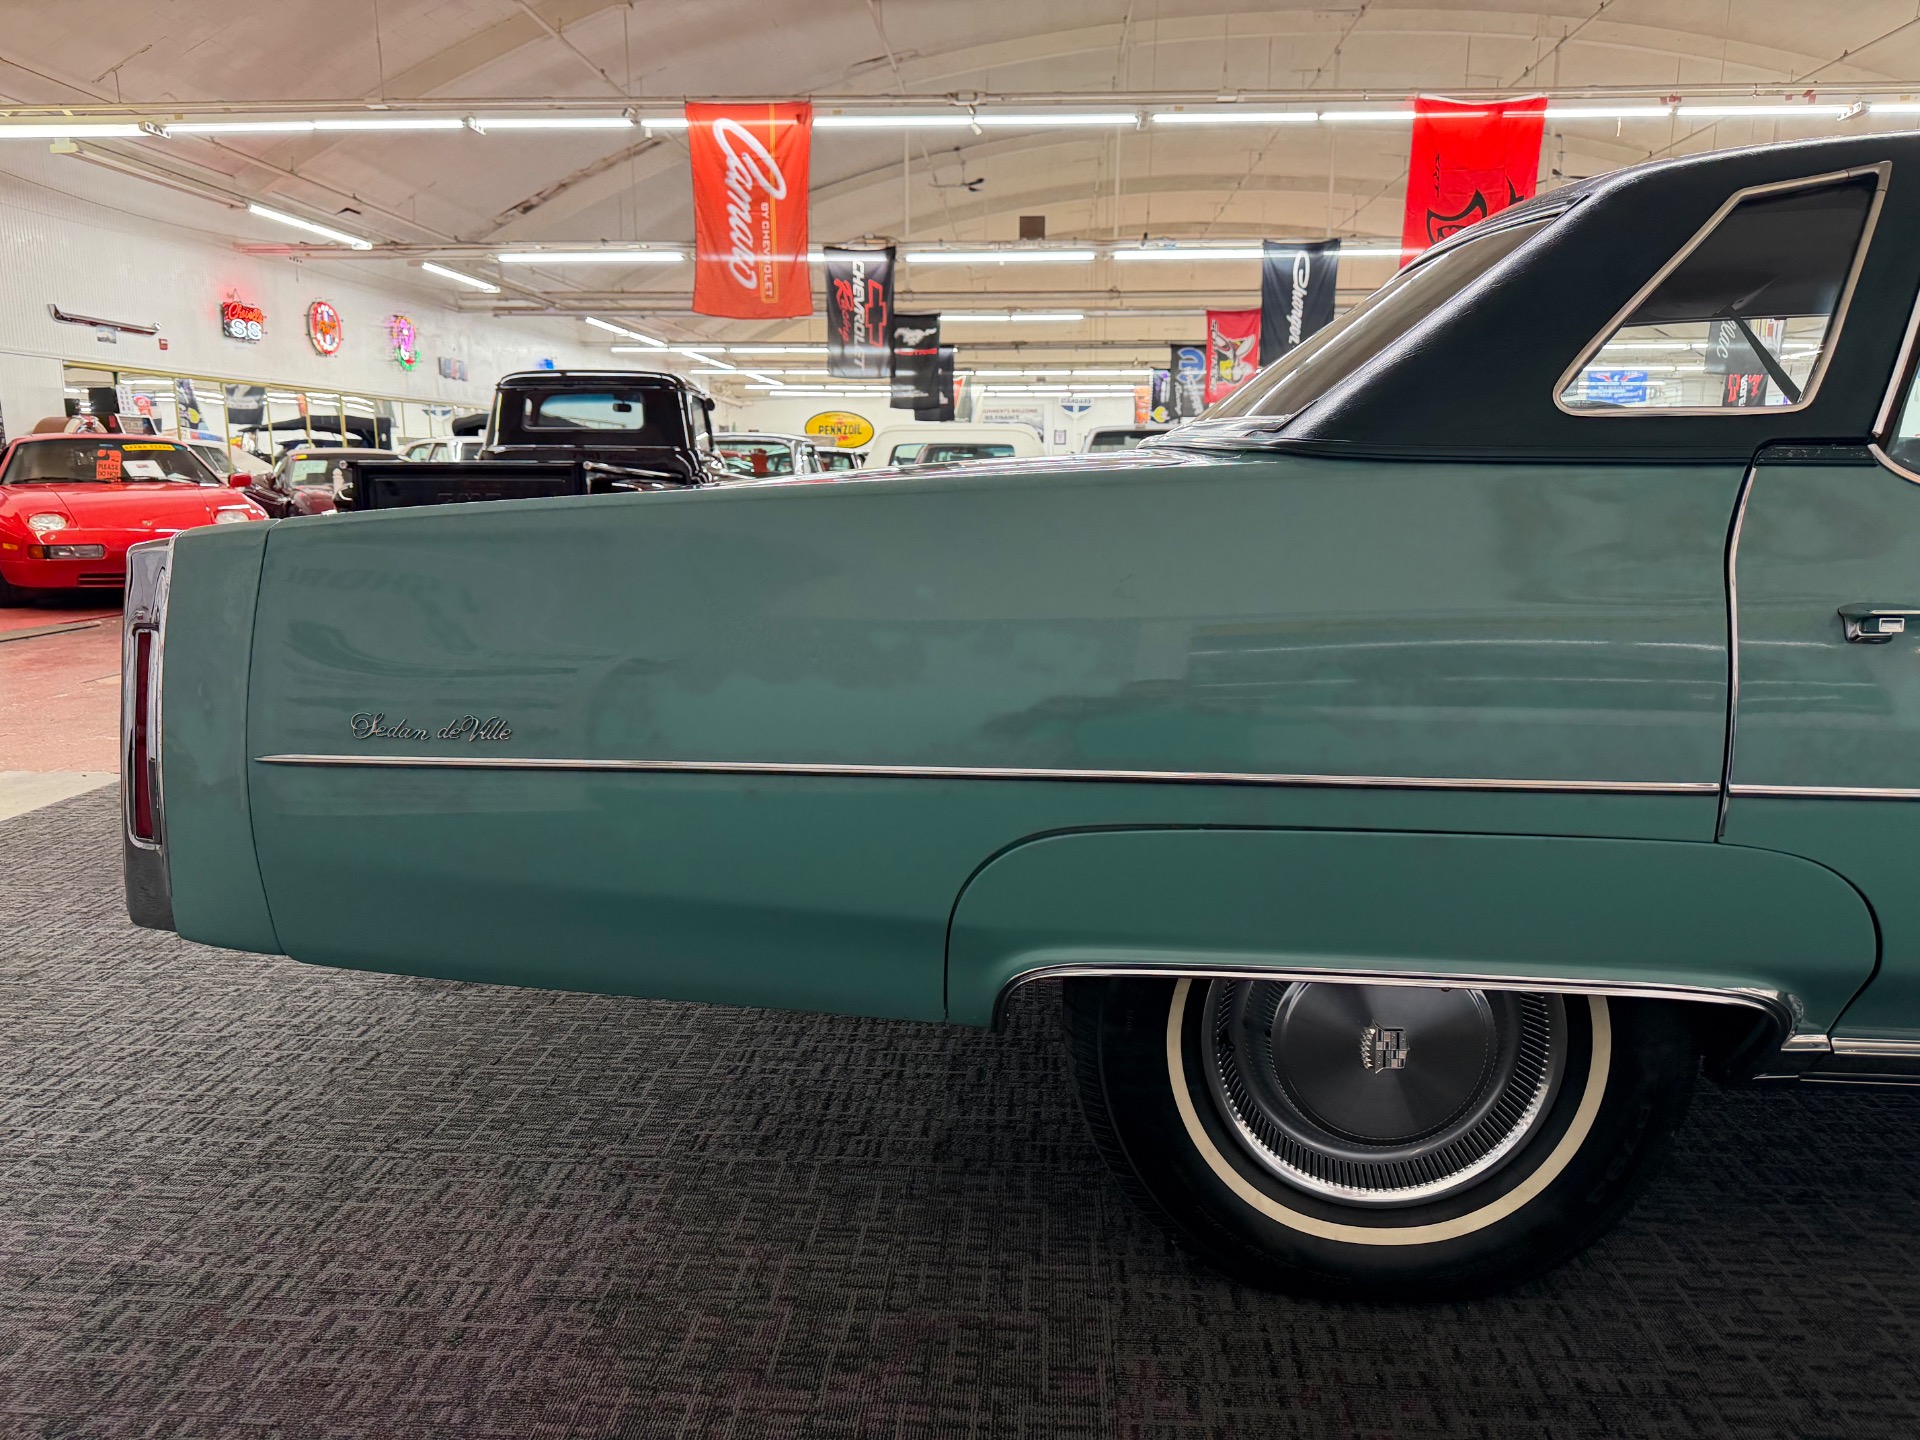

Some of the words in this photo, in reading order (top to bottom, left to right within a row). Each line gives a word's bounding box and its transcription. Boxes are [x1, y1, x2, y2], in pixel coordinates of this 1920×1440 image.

[713, 118, 787, 290] Camaro
[761, 202, 770, 218] BY
[761, 221, 773, 297] CHEVROLET
[230, 318, 262, 340] SS
[834, 277, 855, 342] Racing
[852, 259, 865, 370] CHEVROLET
[1286, 250, 1311, 344] Charger
[818, 424, 863, 435] PENNZOIL
[351, 712, 431, 740] Sedan
